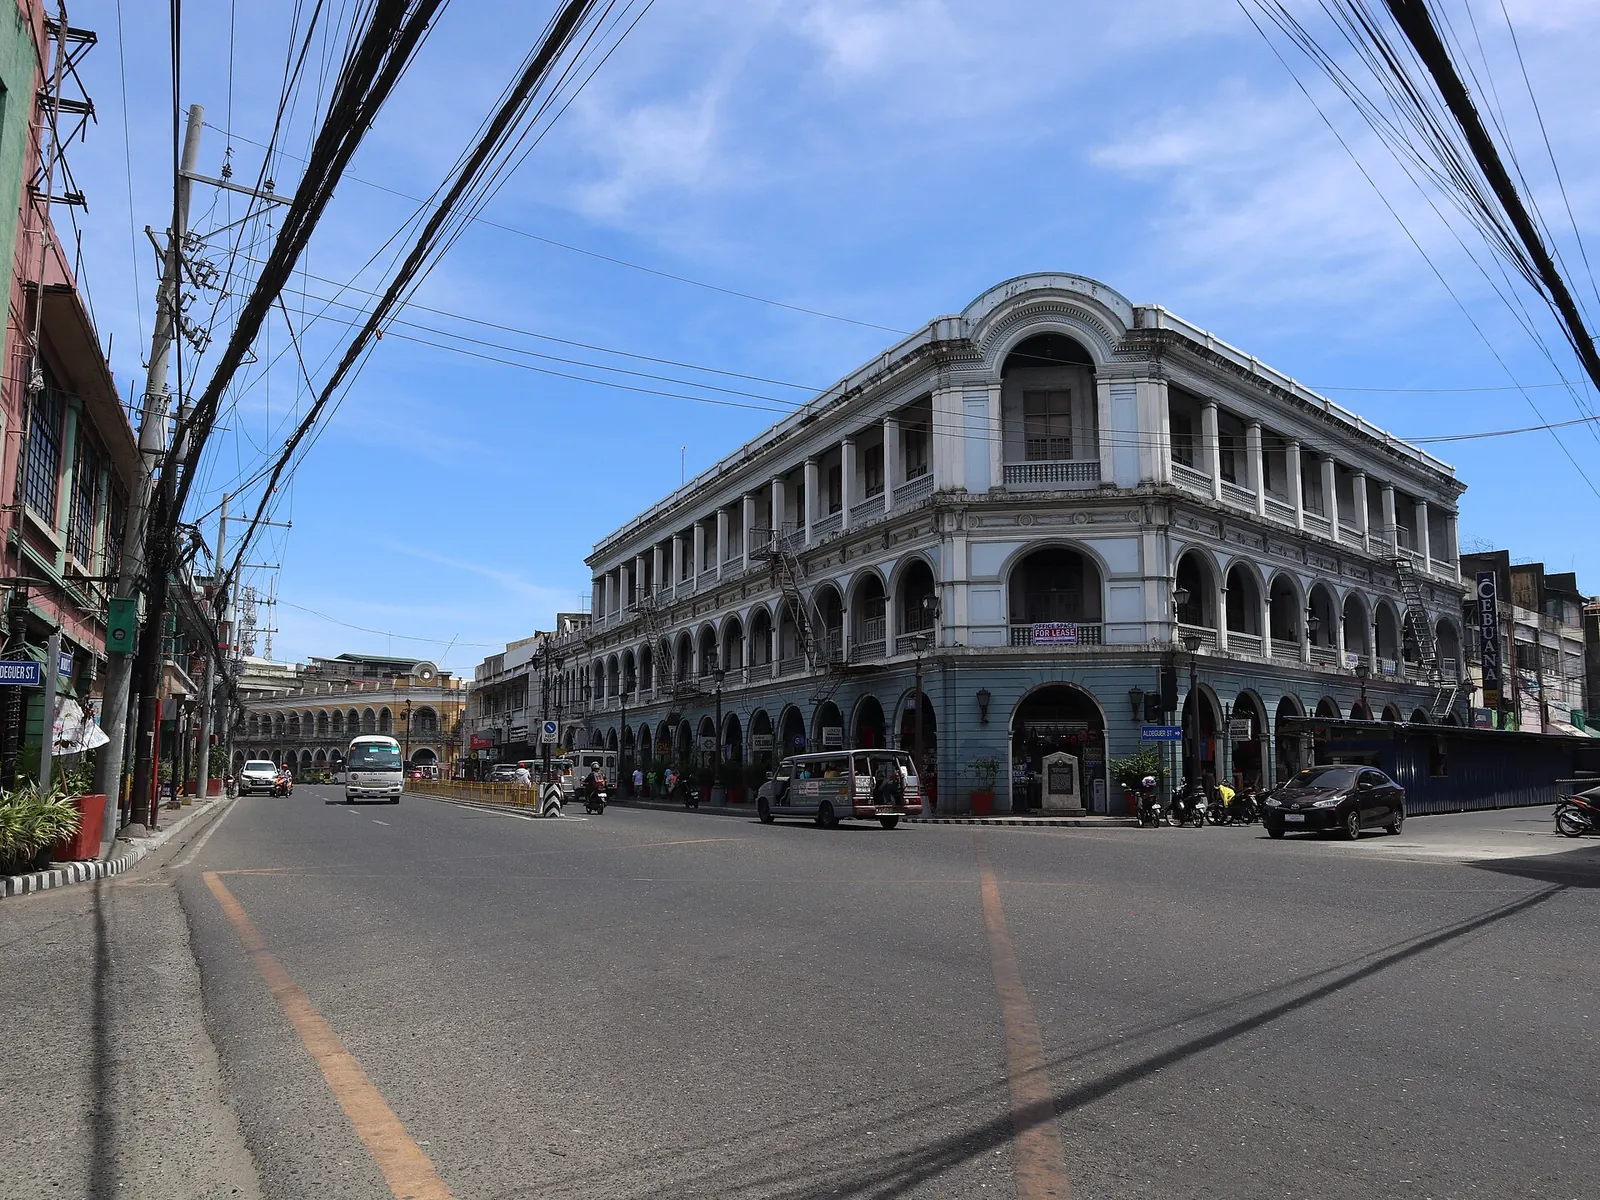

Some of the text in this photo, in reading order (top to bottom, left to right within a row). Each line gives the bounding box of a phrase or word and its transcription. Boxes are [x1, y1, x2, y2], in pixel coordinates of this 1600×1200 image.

[1035, 628, 1075, 637] FOR LEASE
[1477, 579, 1498, 681] CEBUANA
[25, 666, 35, 680] ST.
